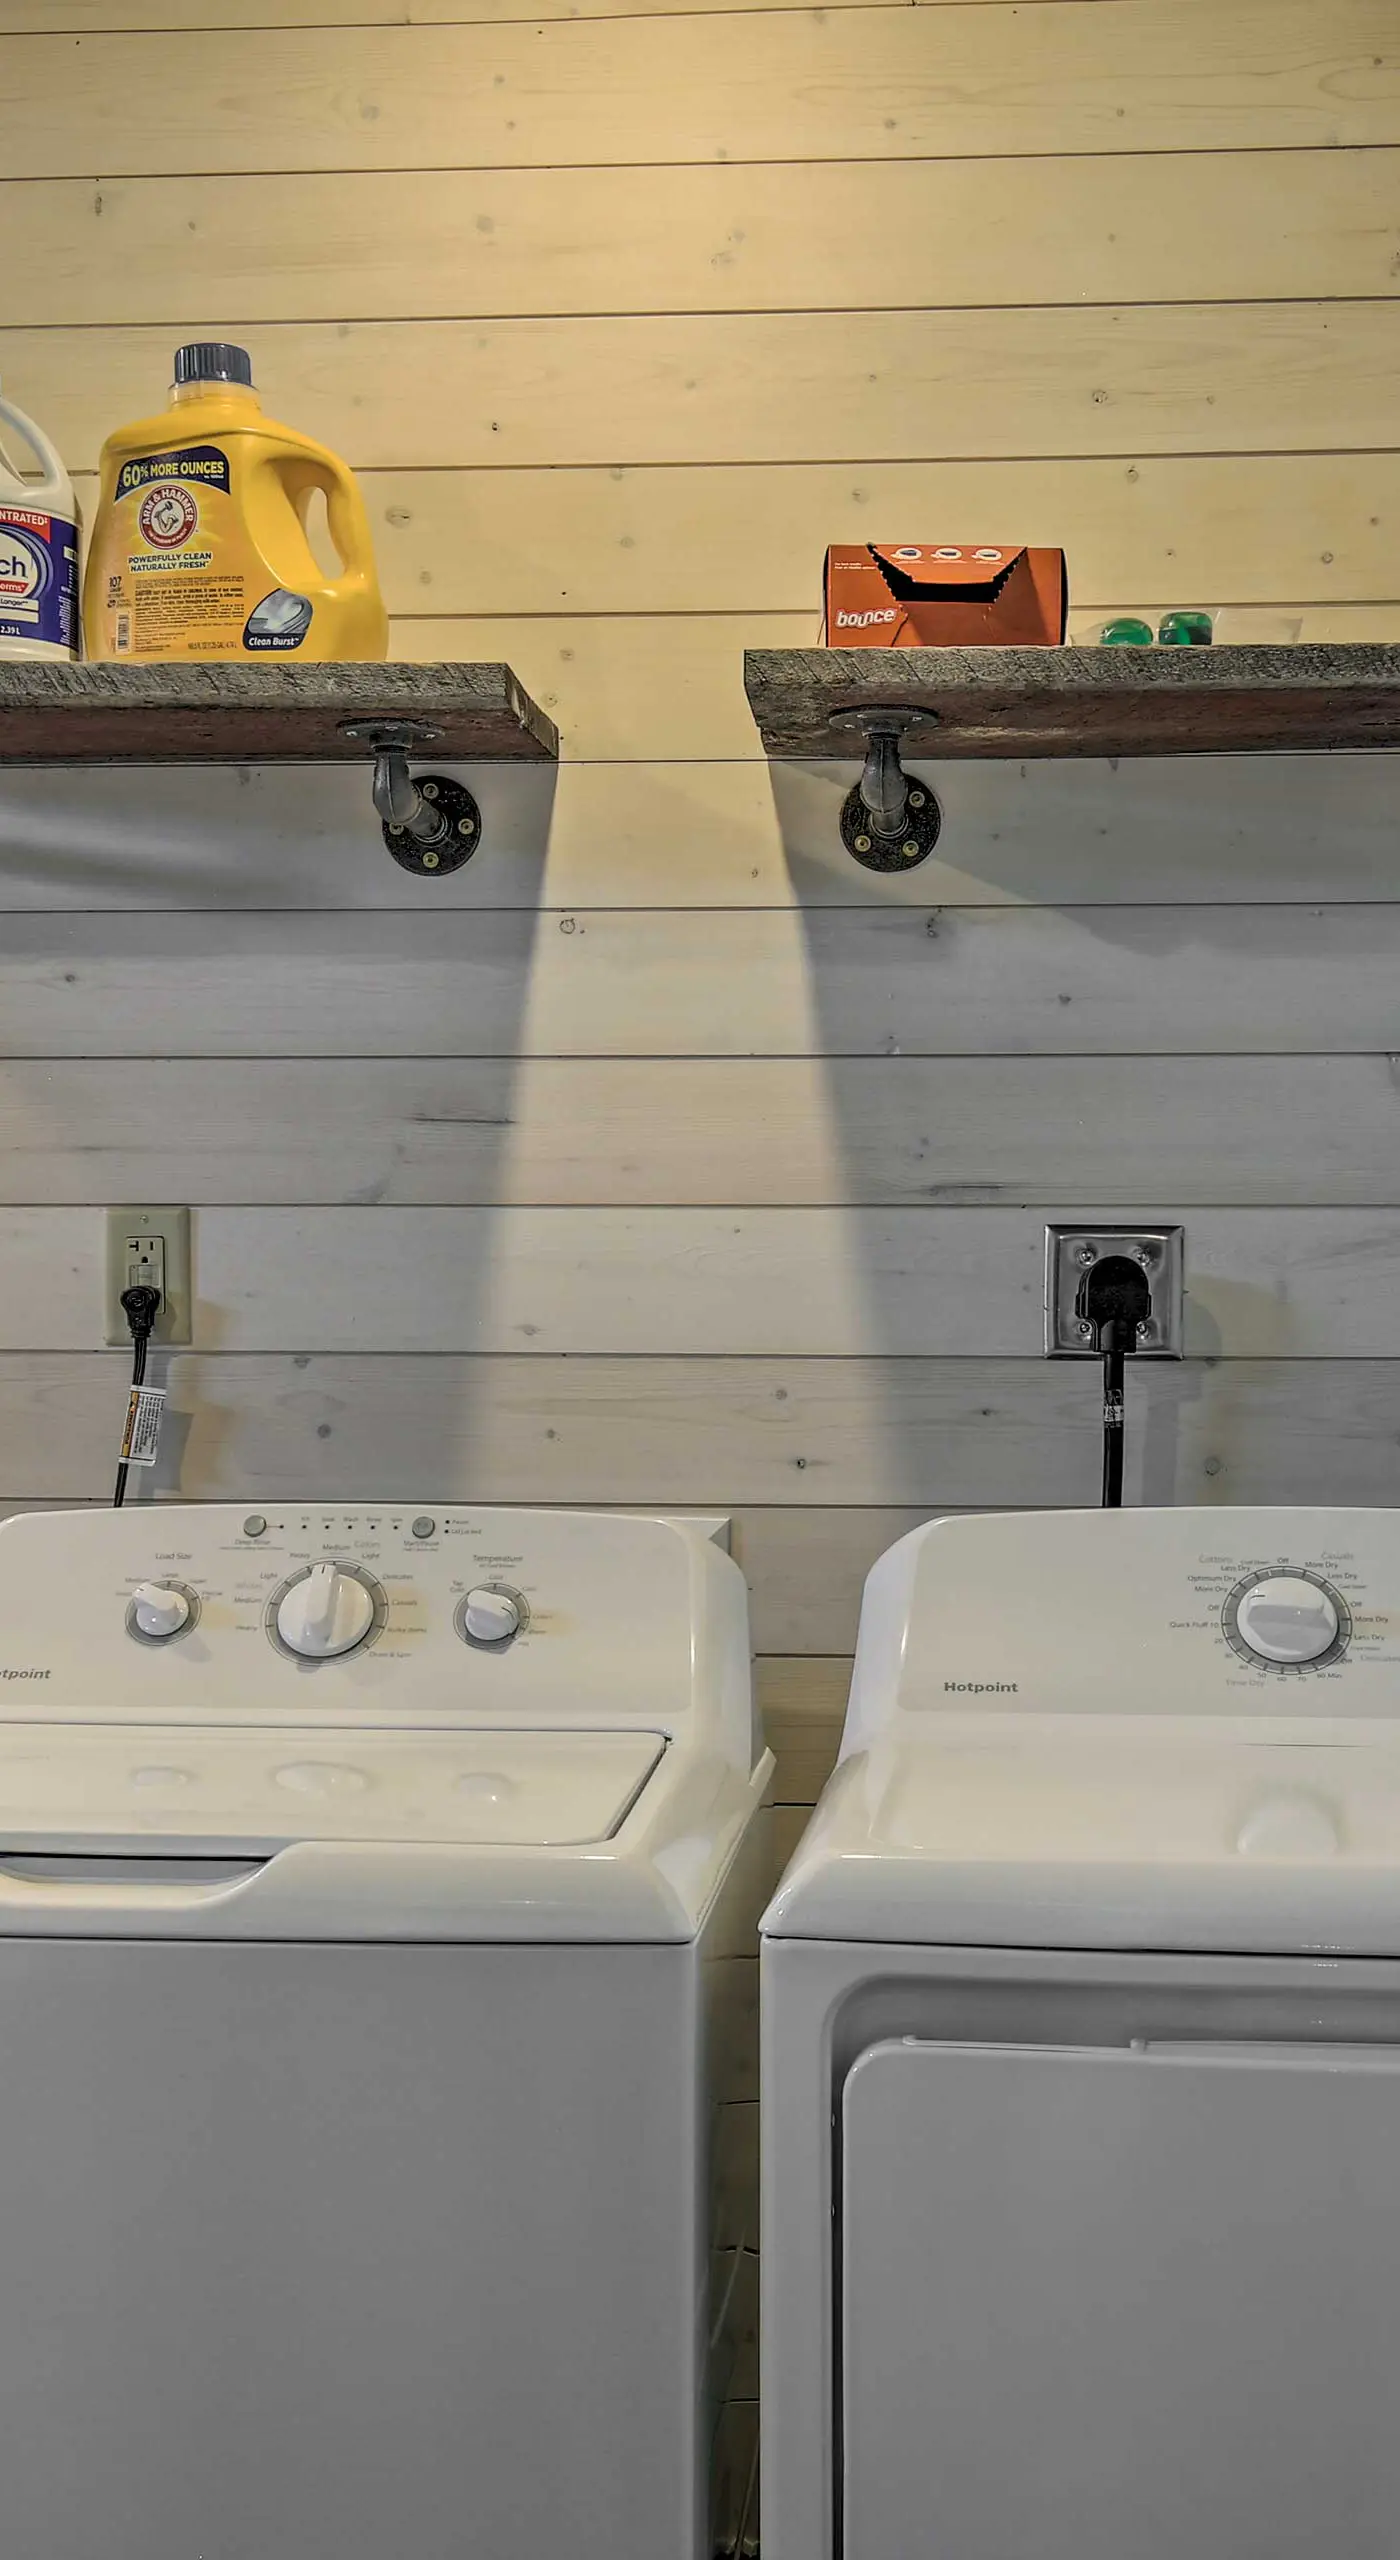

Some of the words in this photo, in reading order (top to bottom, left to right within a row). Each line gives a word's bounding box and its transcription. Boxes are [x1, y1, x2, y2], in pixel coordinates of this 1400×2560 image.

[150, 463, 179, 476] MORE
[180, 461, 225, 475] OUNCES
[142, 500, 155, 525] ARM
[153, 493, 161, 503] &
[161, 488, 194, 522] HAMMER
[128, 554, 181, 564] POWERFULLY
[183, 552, 212, 560] CLEAN
[130, 562, 177, 572] NATURALLY
[109, 576, 122, 588] 107
[837, 608, 897, 628] bounce
[248, 637, 271, 646] Clean
[0, 1668, 51, 1680] tpoint
[944, 1682, 1018, 1694] Hotpoint
